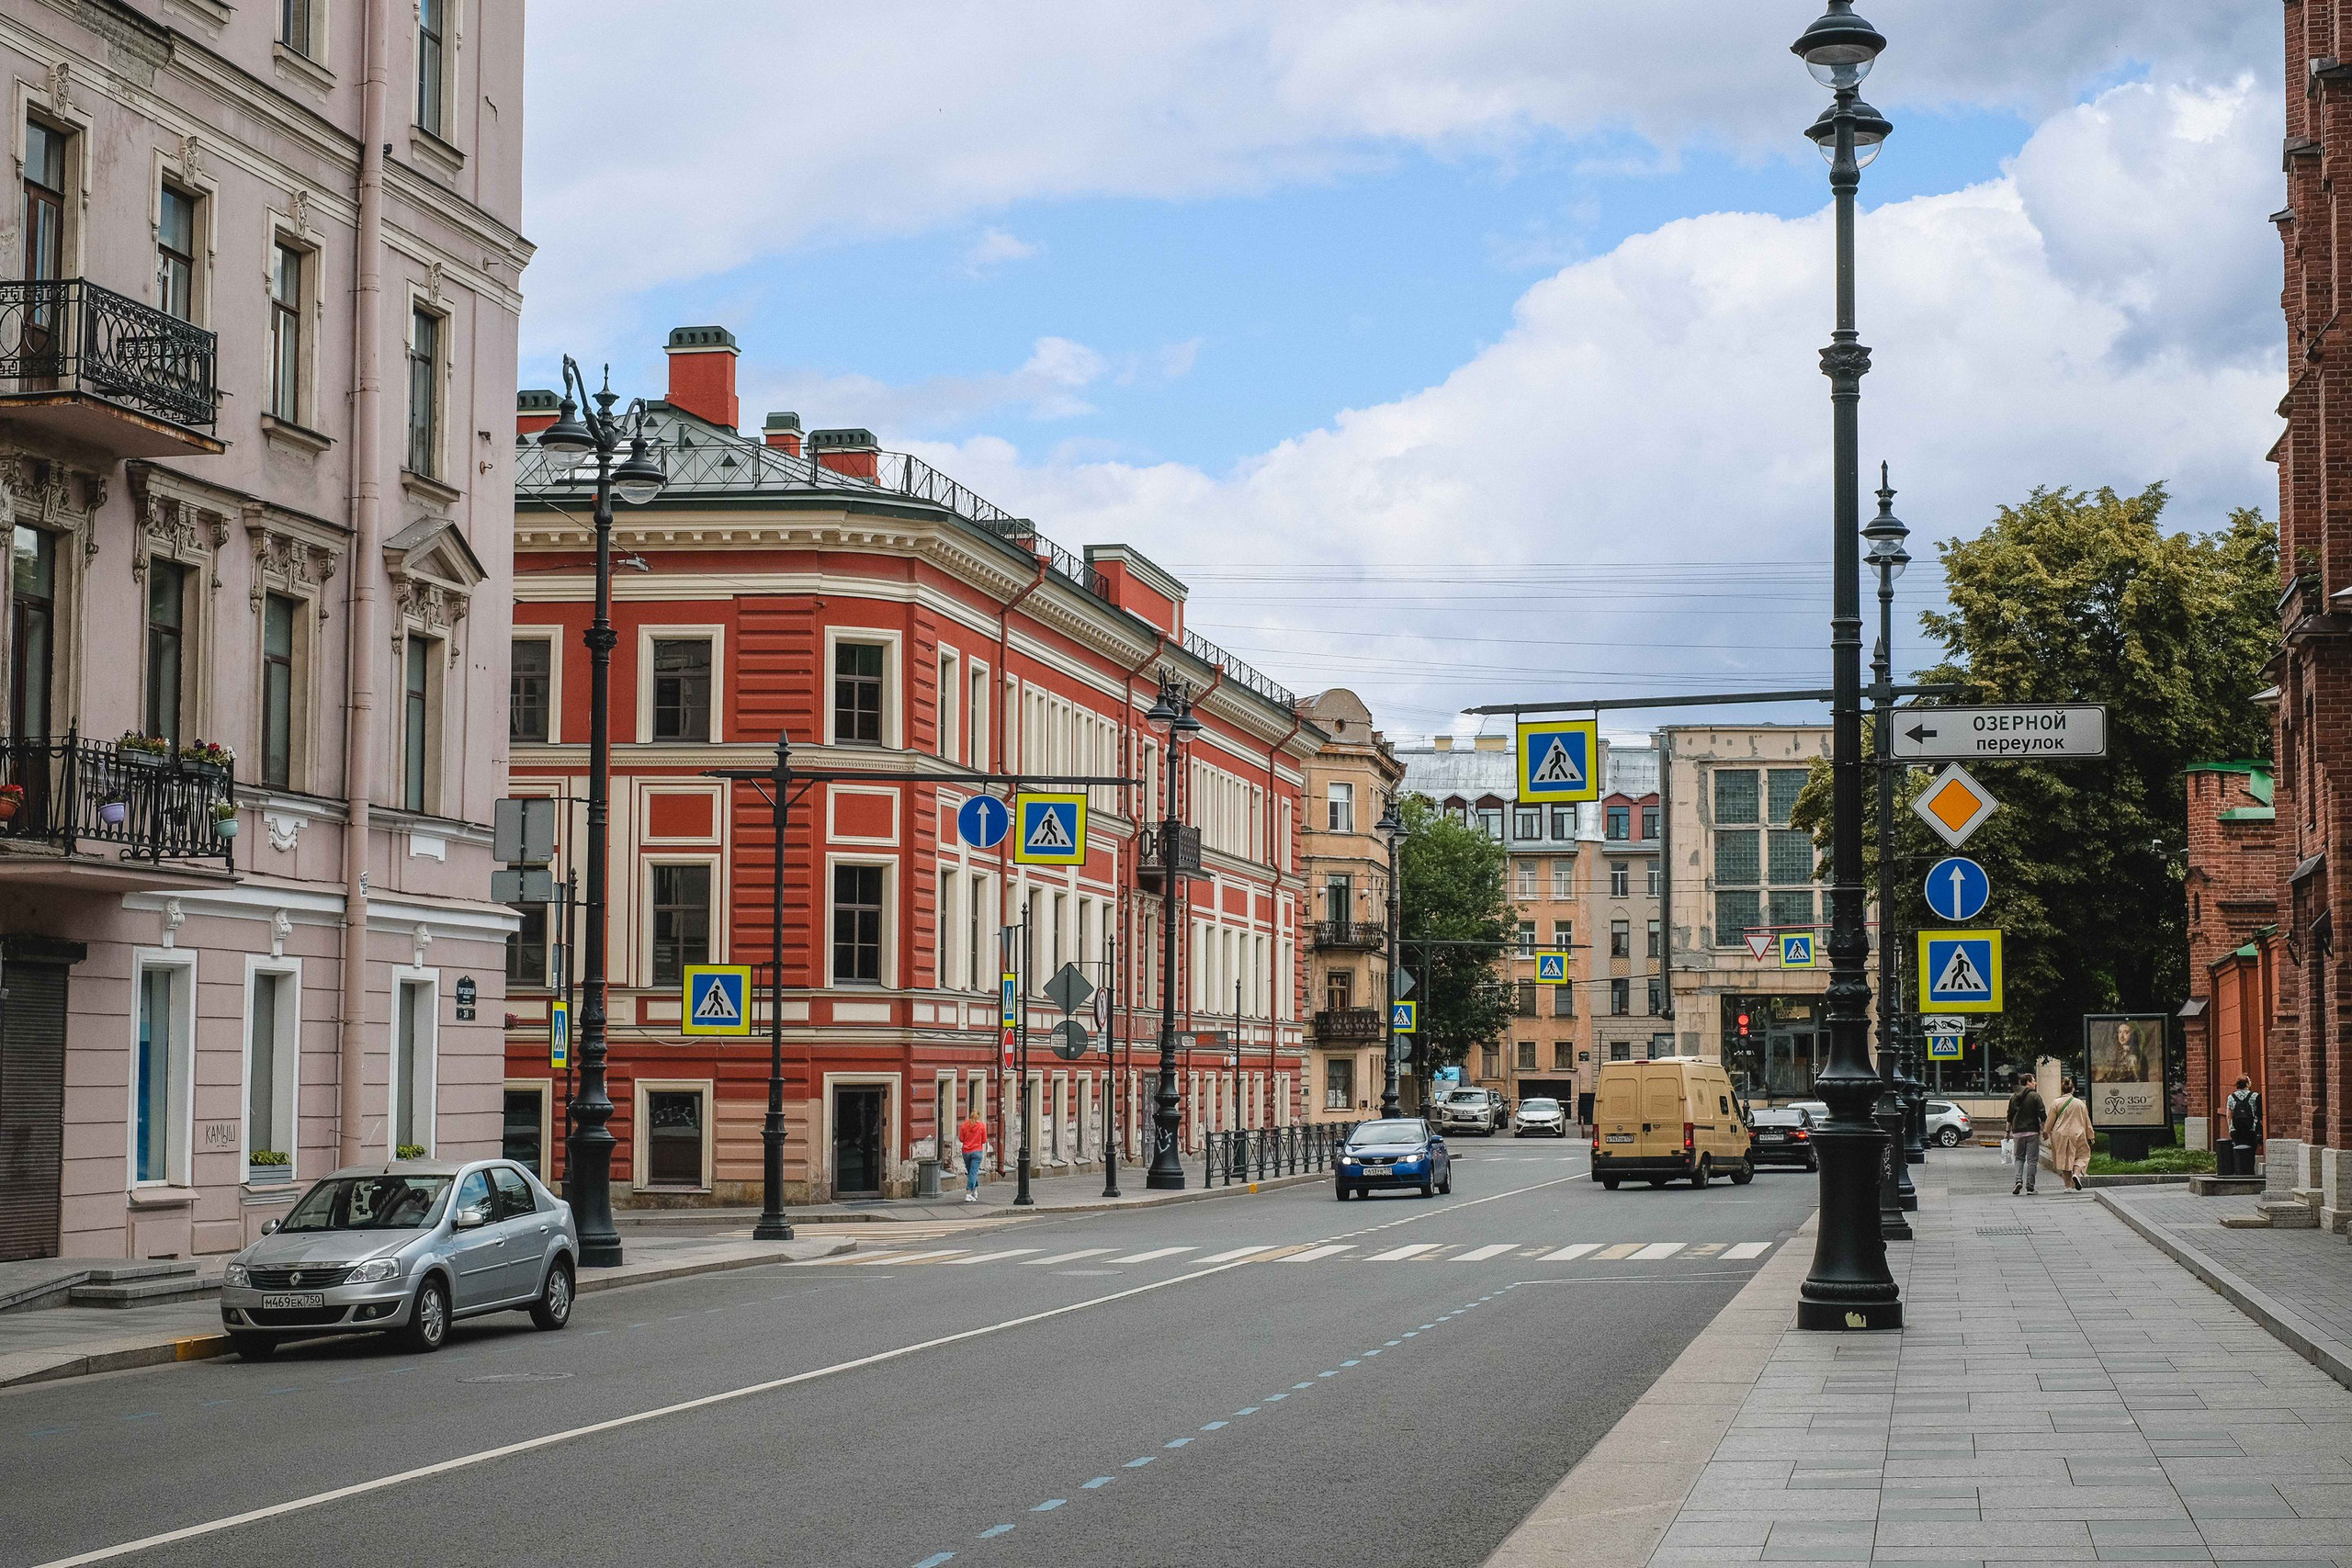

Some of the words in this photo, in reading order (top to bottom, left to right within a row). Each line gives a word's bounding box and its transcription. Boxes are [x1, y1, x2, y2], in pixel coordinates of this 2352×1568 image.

[1973, 711, 2067, 731] ОЗЕРНОЙ
[1976, 737, 2064, 753] переулок
[2127, 1096, 2147, 1104] 350
[265, 1296, 303, 1308] М469ЕК
[305, 1295, 321, 1304] 750
